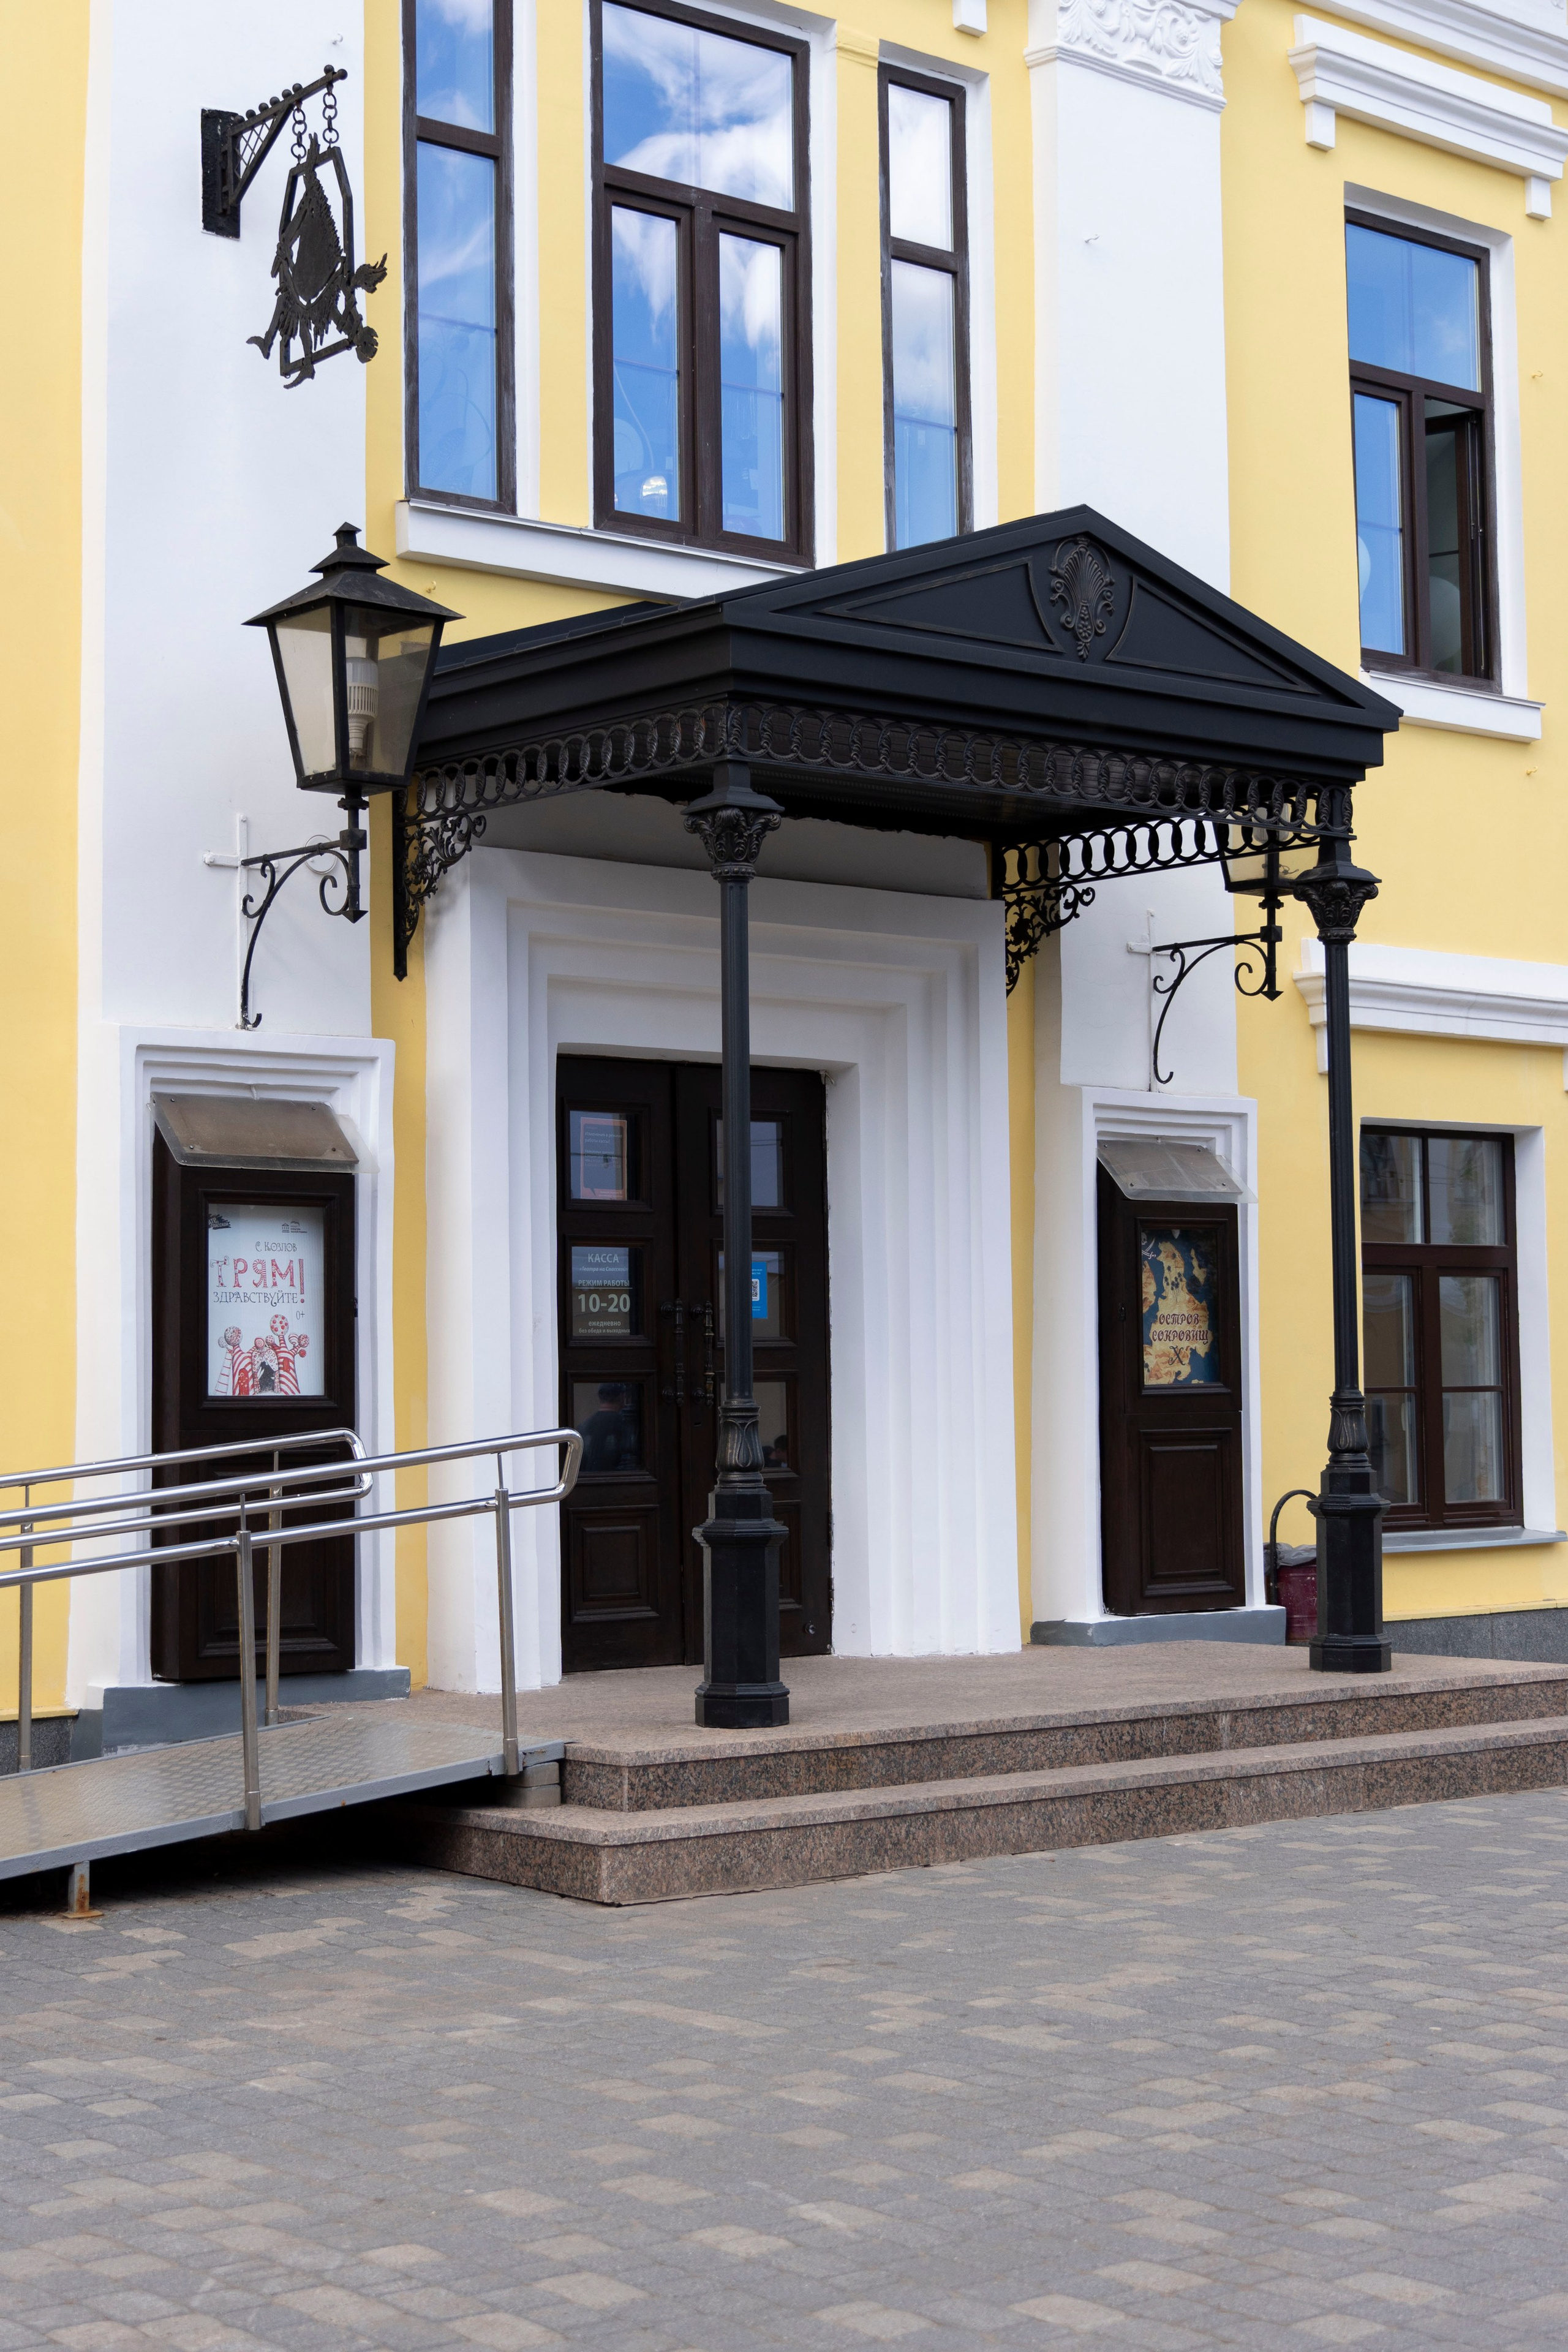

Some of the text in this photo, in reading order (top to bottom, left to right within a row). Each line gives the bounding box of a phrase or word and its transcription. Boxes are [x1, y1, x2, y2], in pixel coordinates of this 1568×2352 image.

[208, 1217, 217, 1226] АТР
[264, 1242, 297, 1252] КОЗЛОВ
[588, 1254, 619, 1263] КАССА
[578, 1294, 630, 1313] 10-20
[296, 1310, 305, 1320] 0+
[1158, 1313, 1199, 1325] ОСТРОВ
[1152, 1330, 1209, 1345] СОКРОВИЩ
